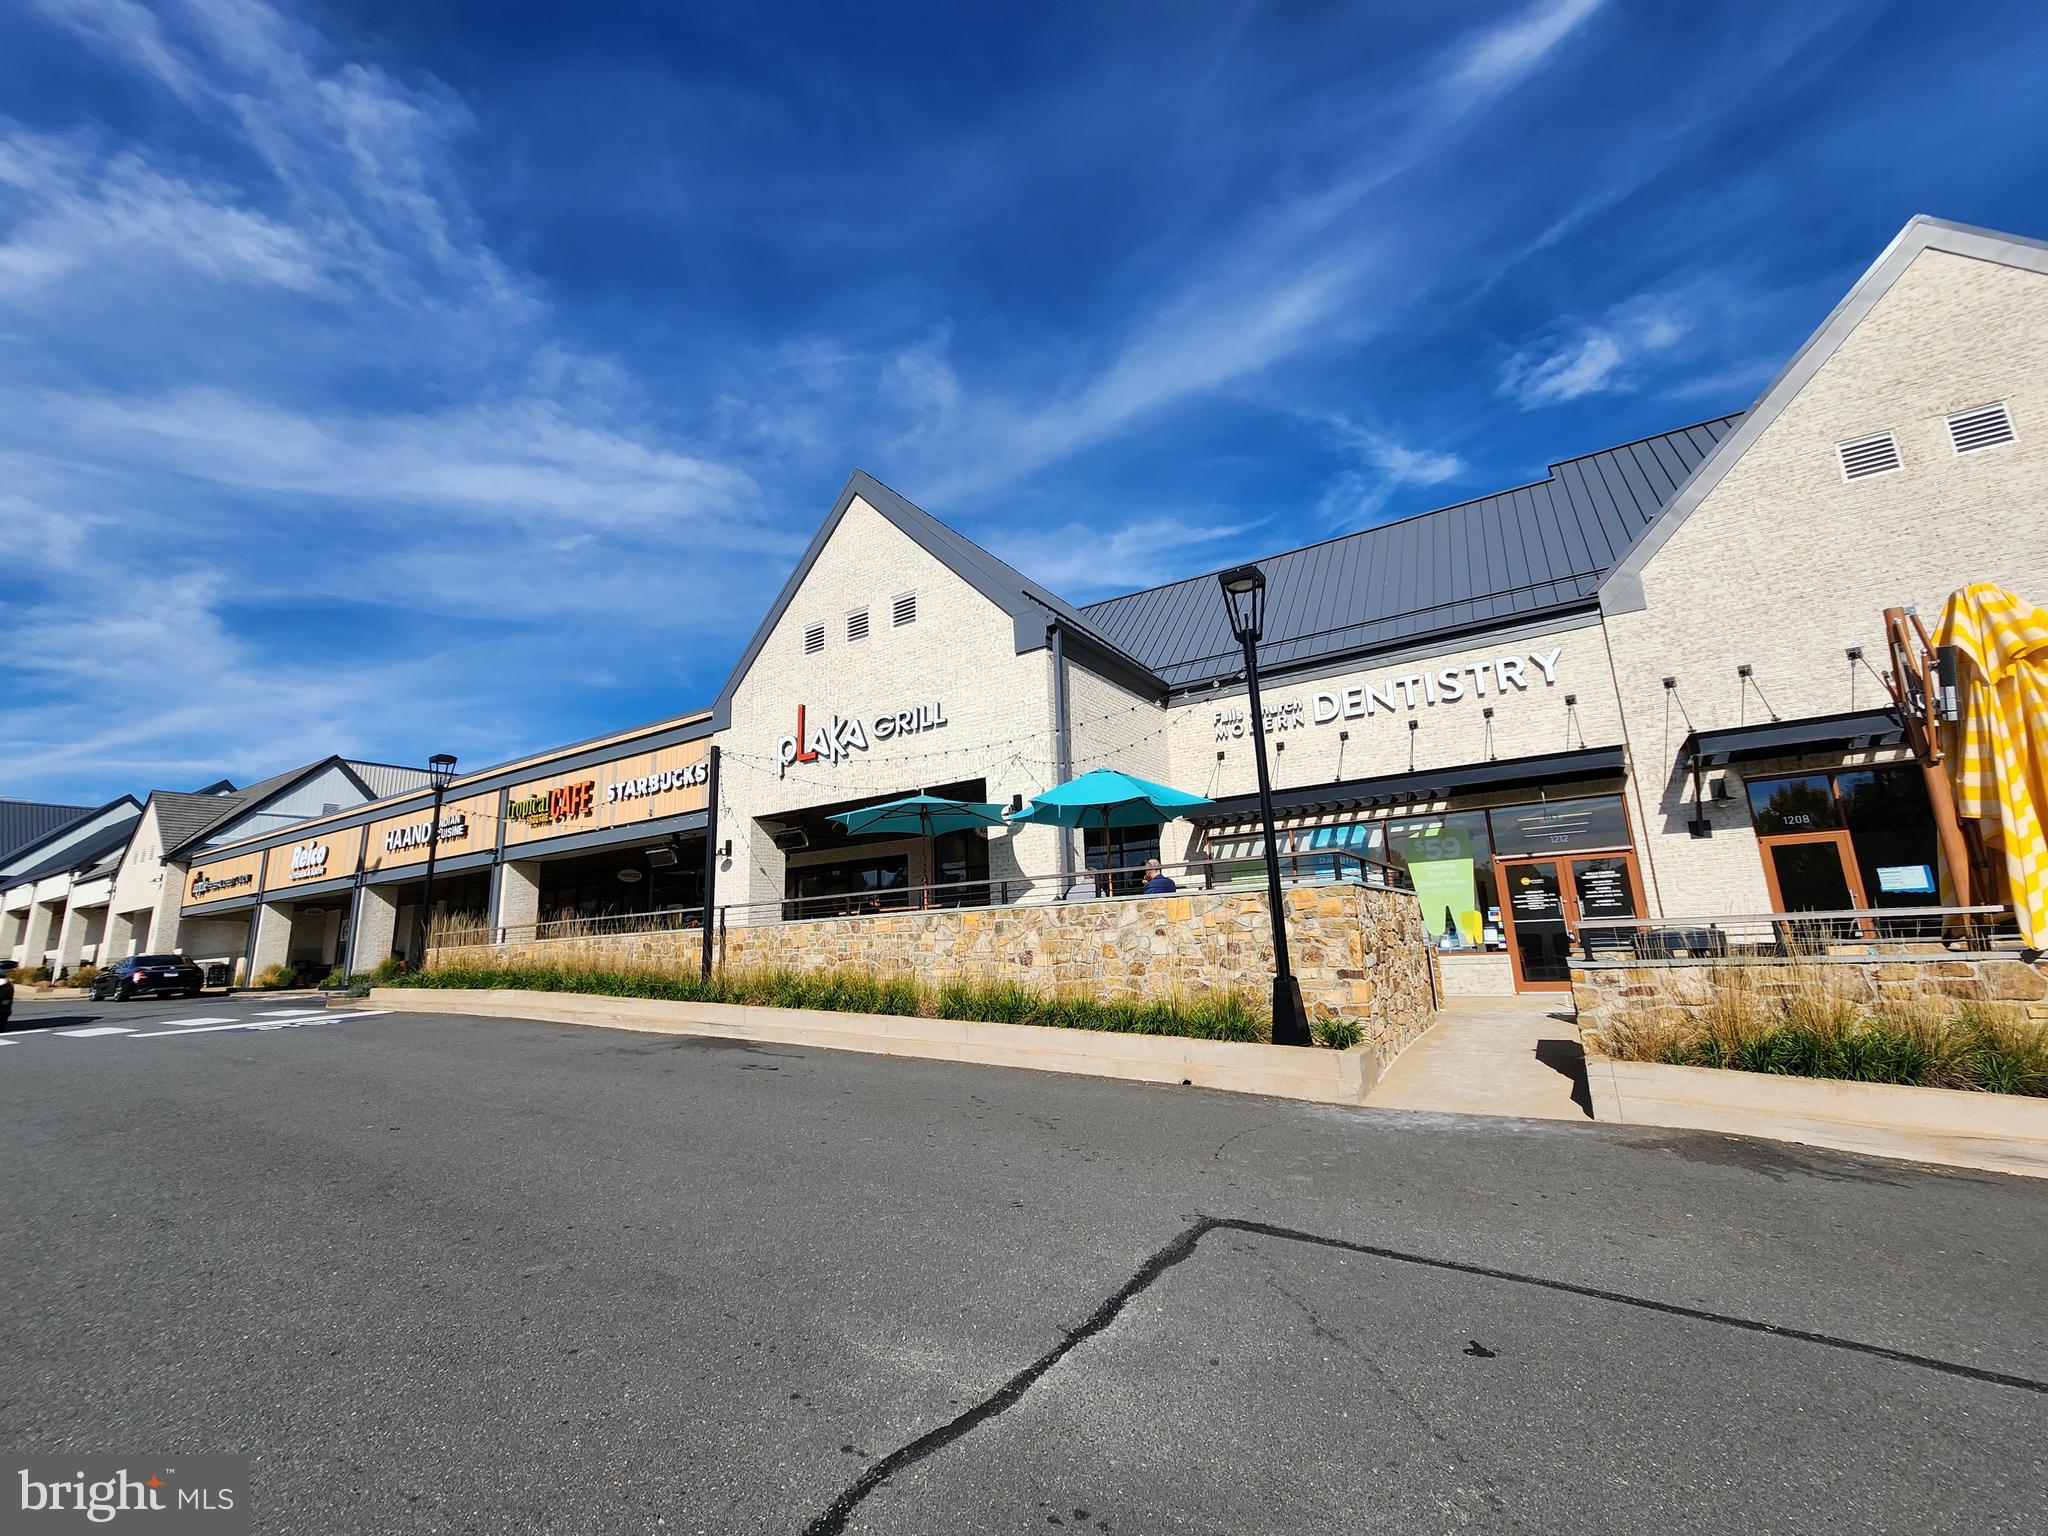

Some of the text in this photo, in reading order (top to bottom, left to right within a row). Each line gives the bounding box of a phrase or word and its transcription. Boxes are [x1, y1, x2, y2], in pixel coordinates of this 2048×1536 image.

[1312, 647, 1562, 723] DENTISTRY
[872, 702, 947, 738] GRILL
[1212, 698, 1303, 724] Falls hurch
[607, 763, 707, 802] STARBUCKS
[507, 780, 590, 820] tropical CAFE
[438, 814, 462, 828] NDIAN
[1782, 814, 1810, 825] 1208
[385, 822, 432, 851] HAAND
[1414, 836, 1461, 860] $59
[1550, 834, 1569, 844] 1212
[290, 841, 328, 870] Reico
